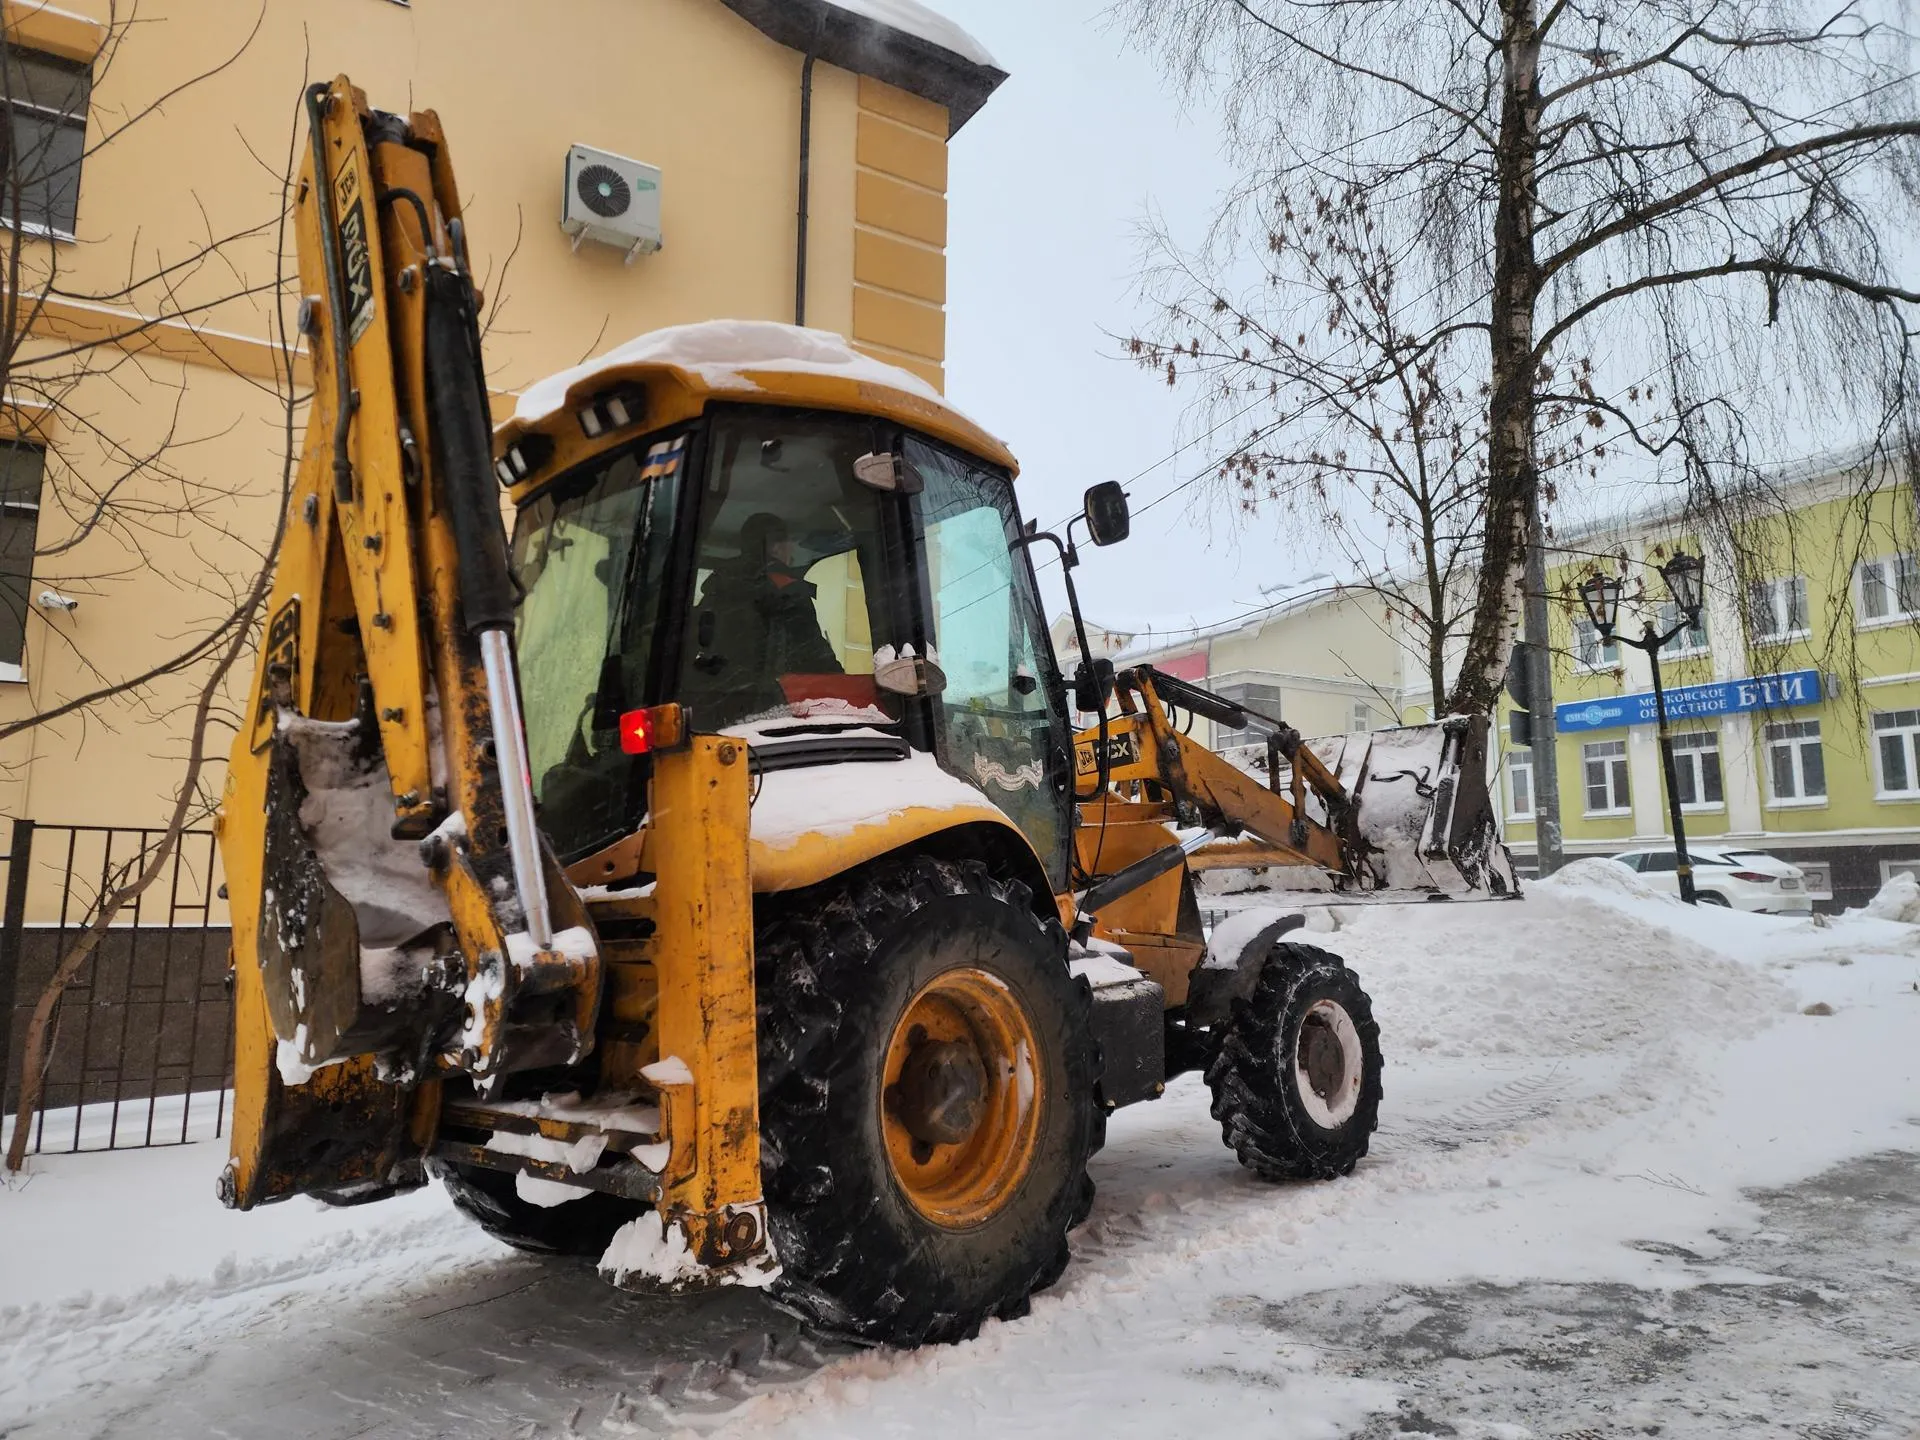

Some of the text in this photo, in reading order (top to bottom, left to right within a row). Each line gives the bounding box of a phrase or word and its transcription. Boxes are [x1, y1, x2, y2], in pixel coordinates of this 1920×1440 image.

[338, 170, 356, 203] JCB
[1639, 688, 1726, 707] МОКОВСКОЕ
[1736, 677, 1805, 706] БТИ
[1078, 749, 1094, 768] JCB
[1096, 742, 1129, 760] CX
